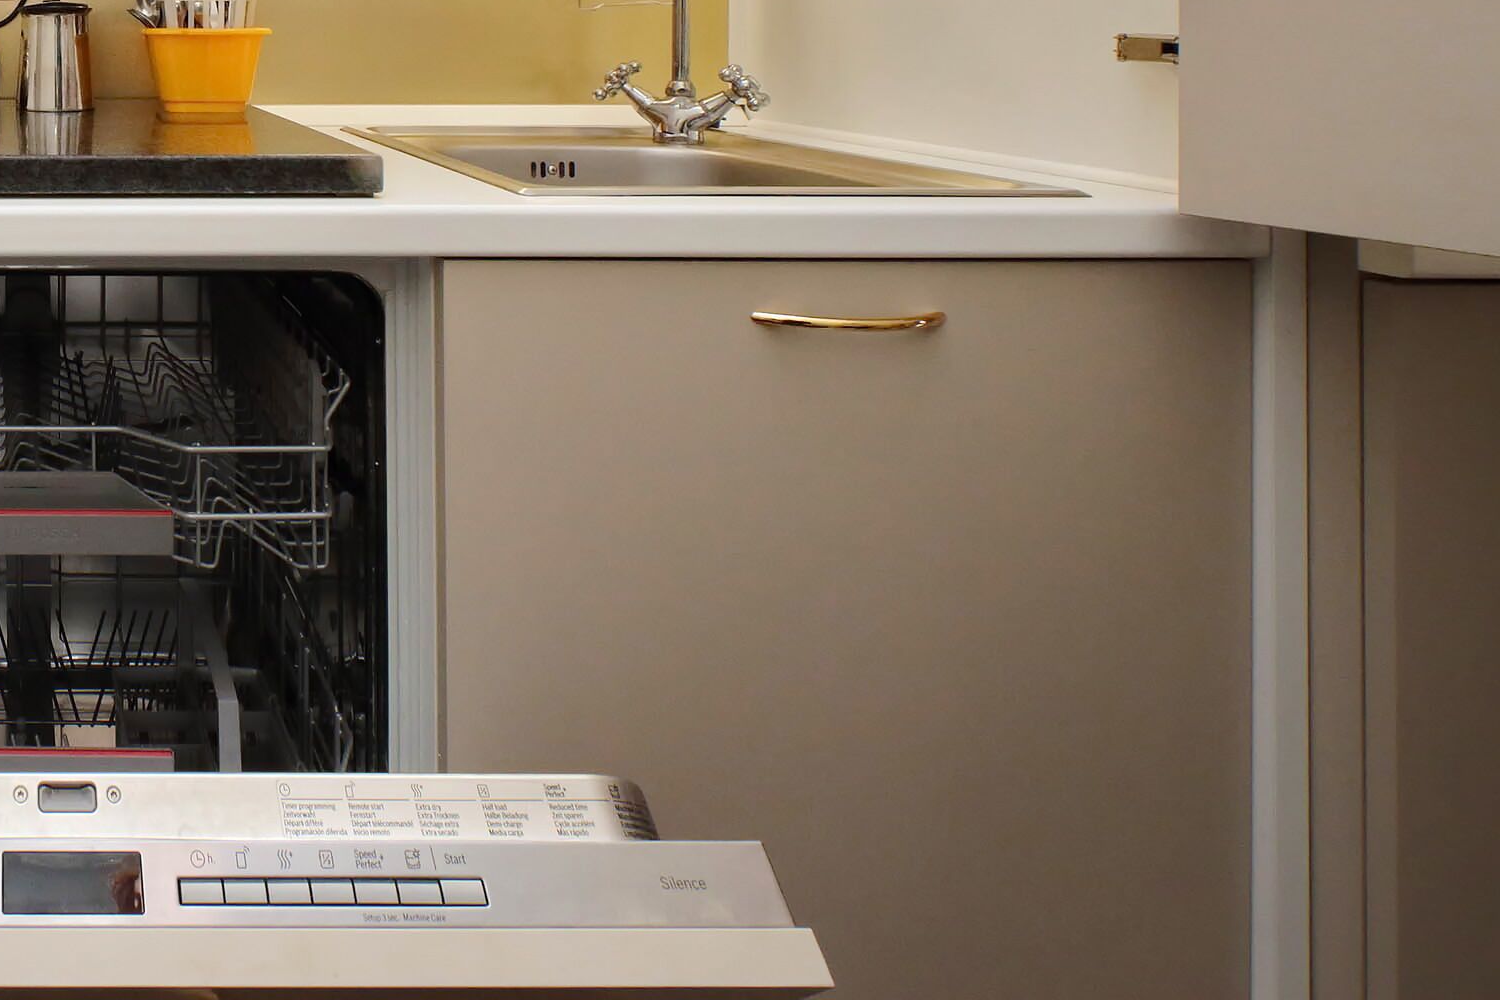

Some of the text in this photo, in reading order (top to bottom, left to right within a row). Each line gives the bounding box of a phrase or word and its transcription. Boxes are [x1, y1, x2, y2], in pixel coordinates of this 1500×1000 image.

[353, 849, 377, 860] Speed
[444, 854, 468, 865] Start
[355, 859, 382, 869] Perfect
[659, 875, 708, 890] Silence
